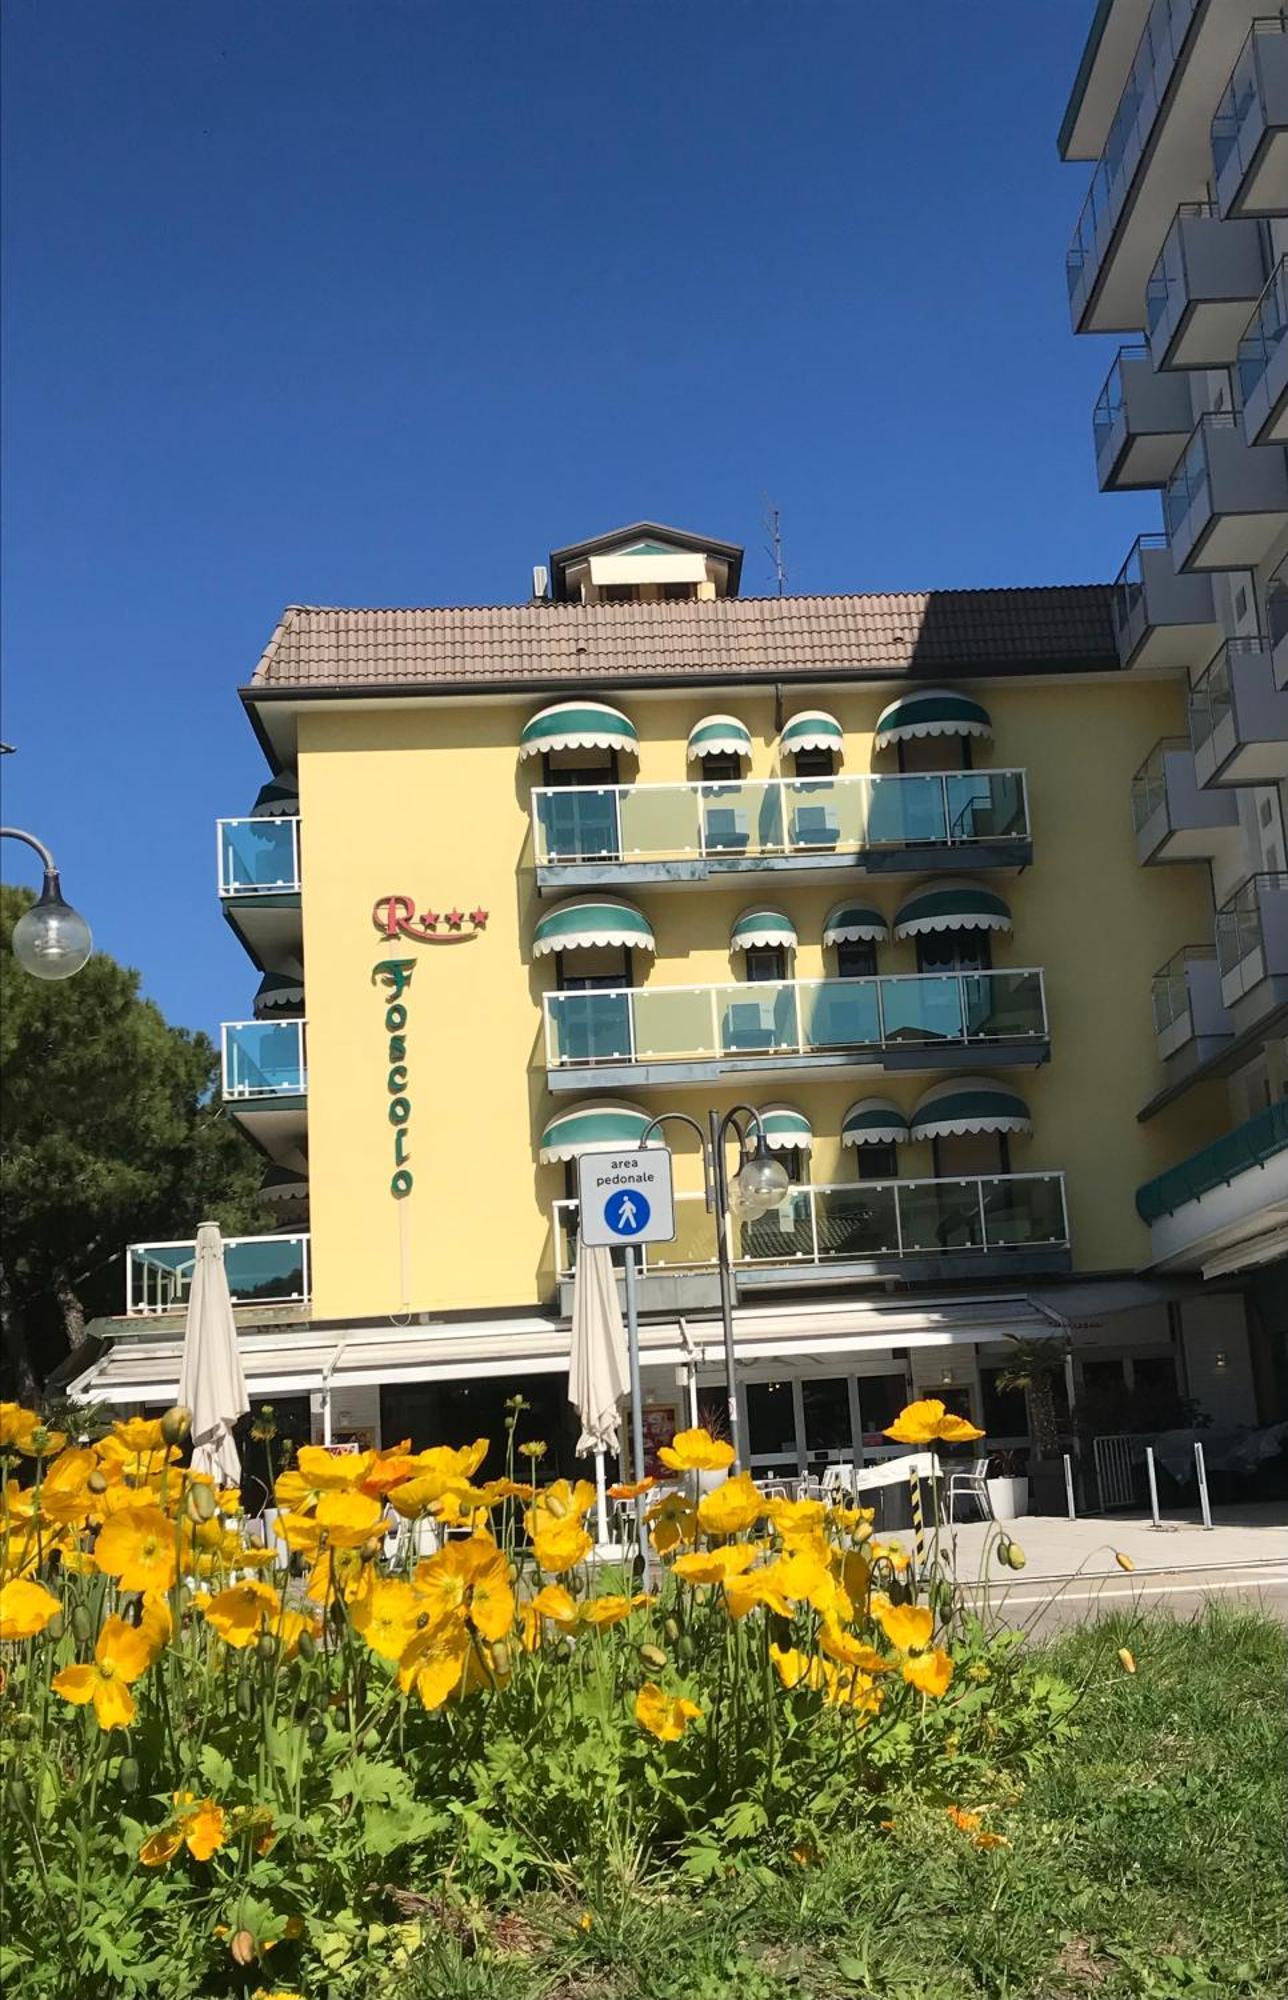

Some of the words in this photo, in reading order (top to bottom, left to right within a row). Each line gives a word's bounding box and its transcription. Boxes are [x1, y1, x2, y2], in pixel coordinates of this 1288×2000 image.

[371, 957, 418, 1200] Foscolo
[611, 1159, 639, 1169] area
[596, 1172, 655, 1187] pedonale
